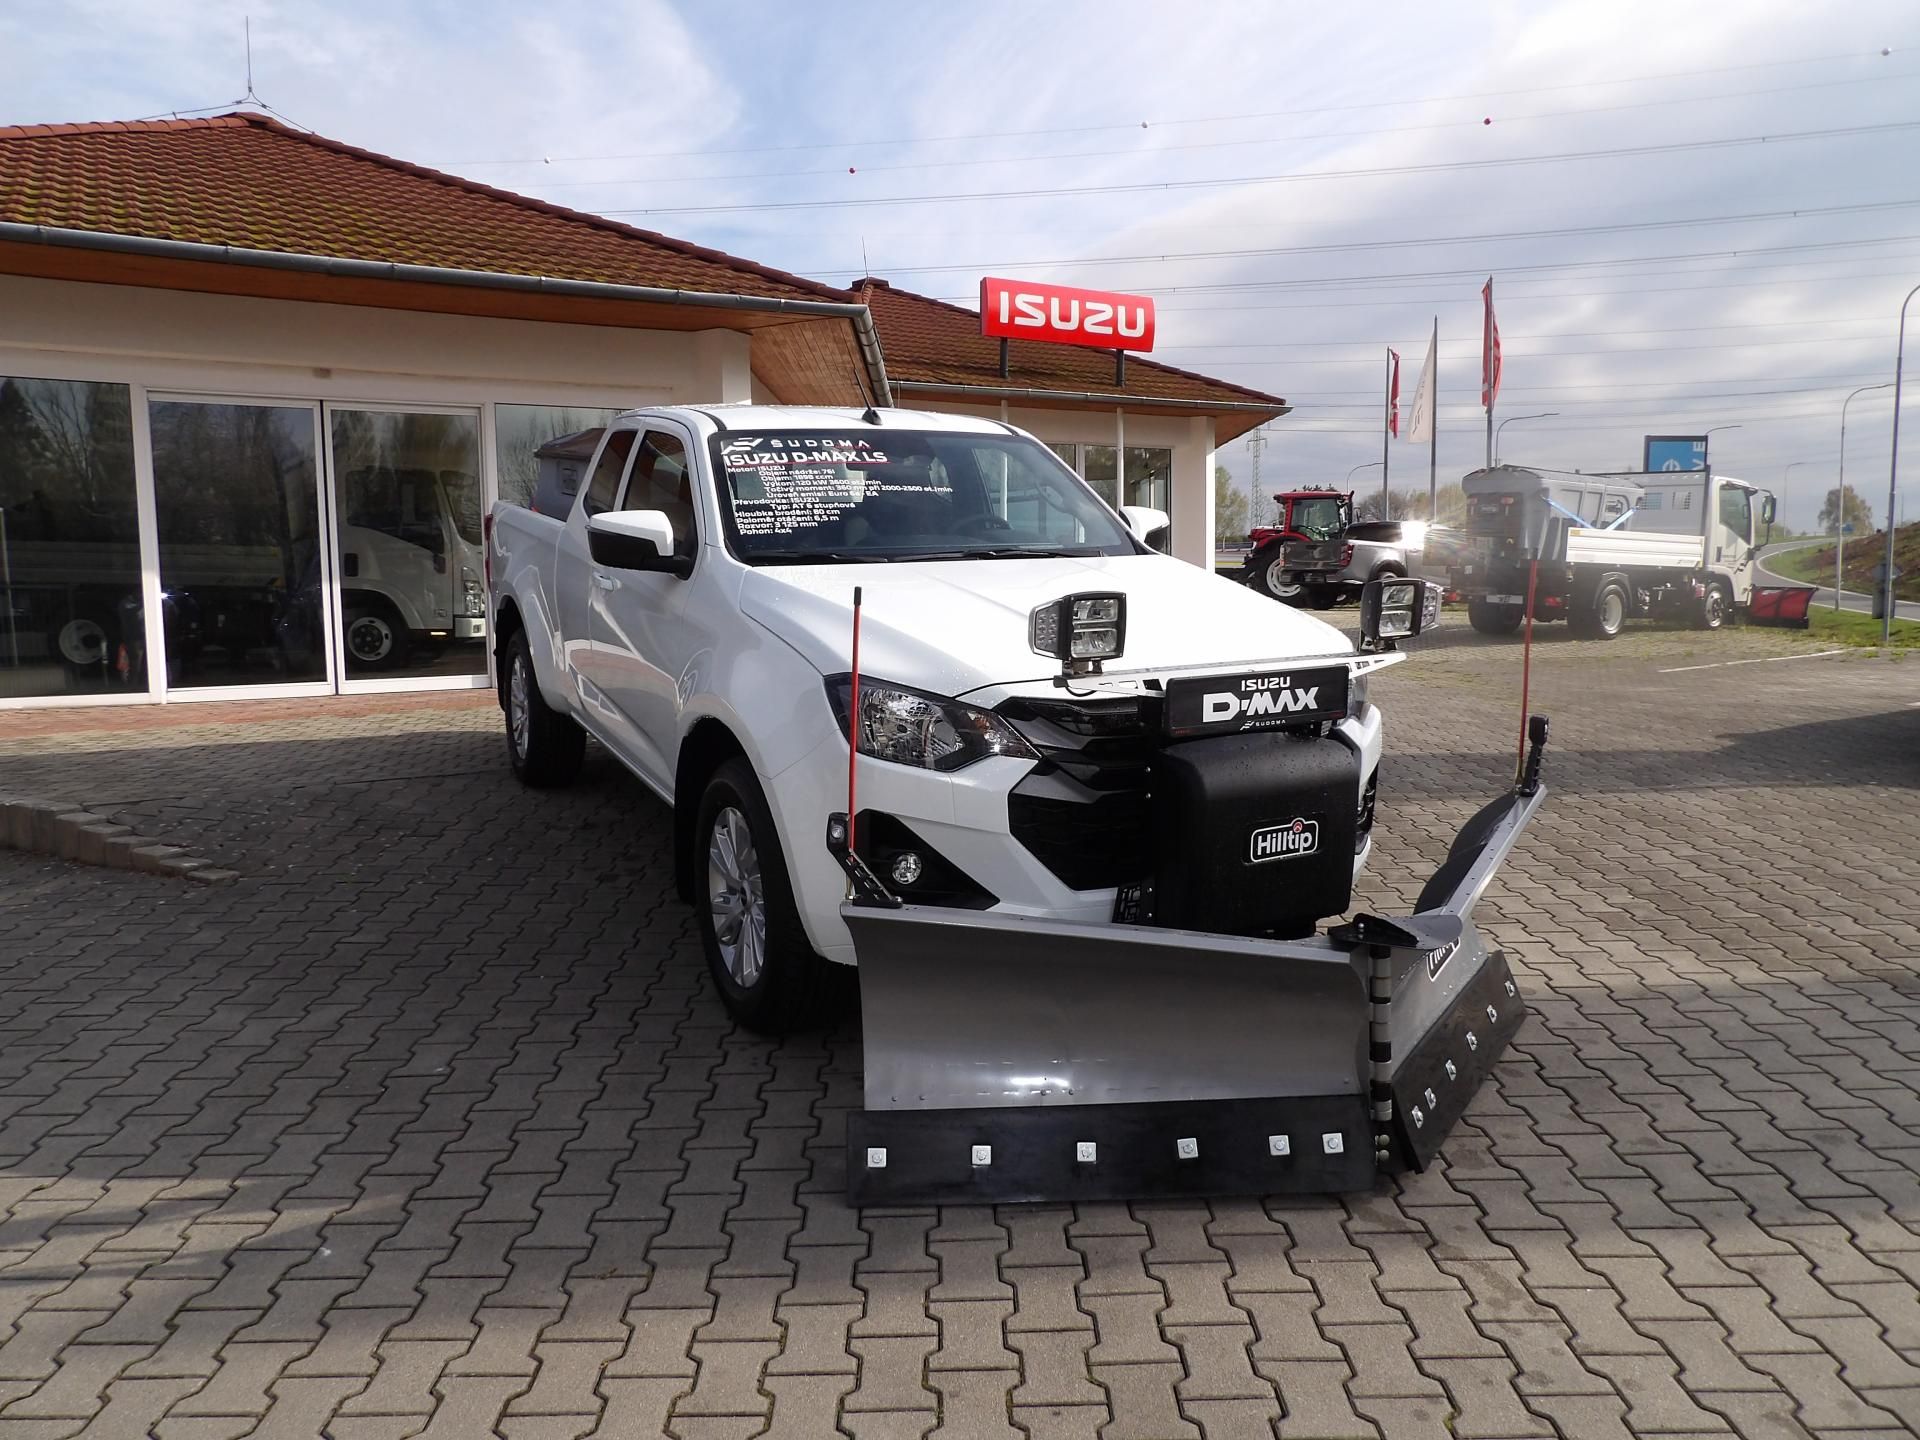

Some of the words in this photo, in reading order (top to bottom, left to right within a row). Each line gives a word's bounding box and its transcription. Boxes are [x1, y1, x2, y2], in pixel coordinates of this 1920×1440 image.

[999, 291, 1146, 338] ISUZU
[770, 438, 871, 448] SUDOMA
[723, 452, 789, 466] ISUZU
[791, 451, 861, 463] D-MAX
[862, 451, 888, 462] LS
[763, 480, 795, 488] Výkon:
[813, 502, 856, 510] stupňová
[735, 510, 774, 518] Hloubka
[774, 509, 812, 517] brodění:
[736, 516, 775, 524] Poloměr
[776, 515, 813, 523] otáčení:
[813, 514, 829, 523] 6,5
[737, 522, 774, 530] Rozvor:
[739, 528, 773, 536] Pohon:
[774, 527, 793, 535] 4x4
[1241, 676, 1291, 691] ISUZU
[1202, 686, 1320, 722] D-MAX
[1257, 822, 1312, 854] Hilltip
